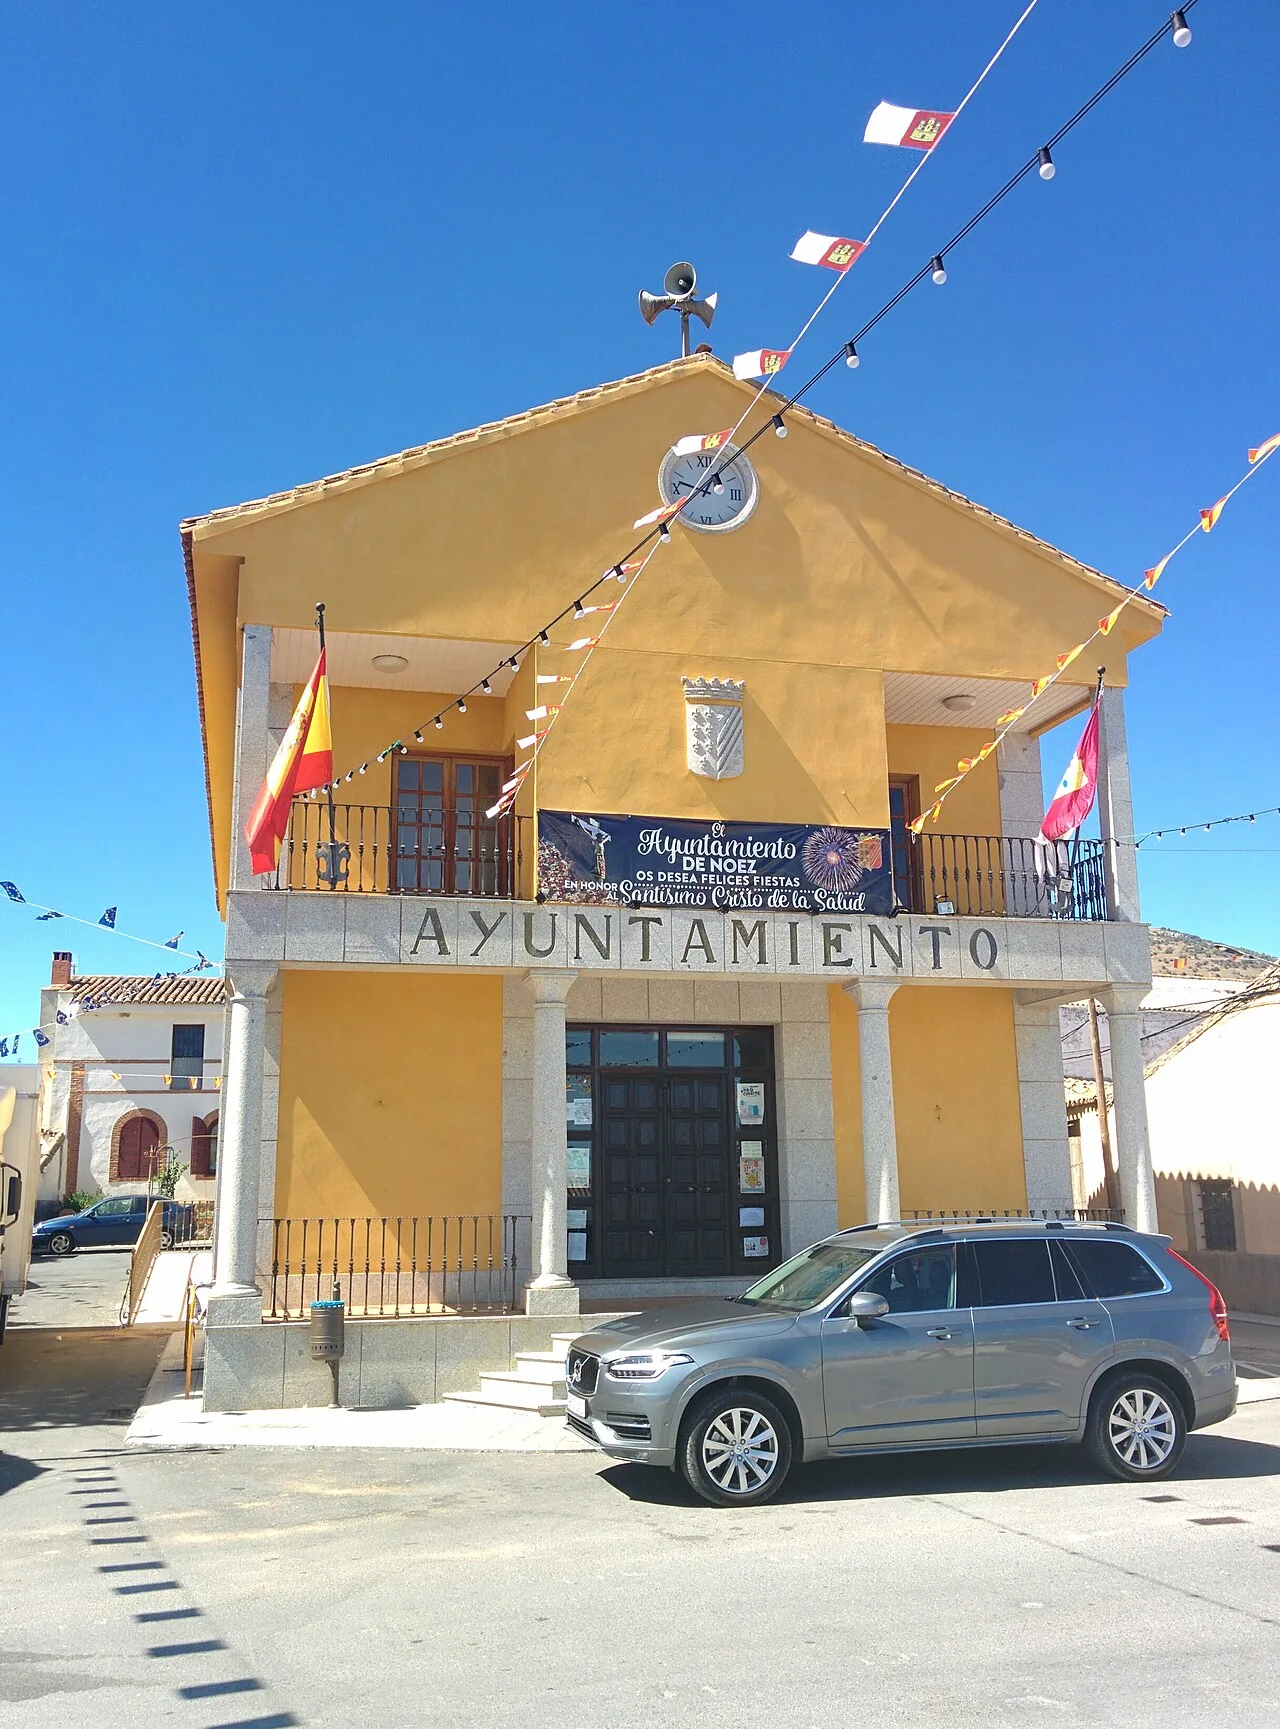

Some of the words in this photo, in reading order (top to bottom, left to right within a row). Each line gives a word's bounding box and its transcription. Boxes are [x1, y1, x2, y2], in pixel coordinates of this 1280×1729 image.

[730, 488, 742, 501] III
[711, 822, 726, 838] El
[637, 827, 797, 864] Ayuntamiento
[682, 856, 706, 872] DE
[710, 857, 757, 874] NOEZ
[564, 879, 578, 889] EN
[580, 880, 618, 892] HONOR
[636, 870, 654, 882] OS
[657, 871, 698, 884] DESEA
[701, 874, 750, 886] FELICES
[753, 875, 801, 888] FIESTAS
[606, 892, 619, 901] AL
[711, 885, 763, 908] Cristo
[767, 888, 790, 909] de
[792, 890, 812, 909] la
[814, 887, 866, 912] Salud
[409, 907, 998, 970] AYUNTAMIENTO
